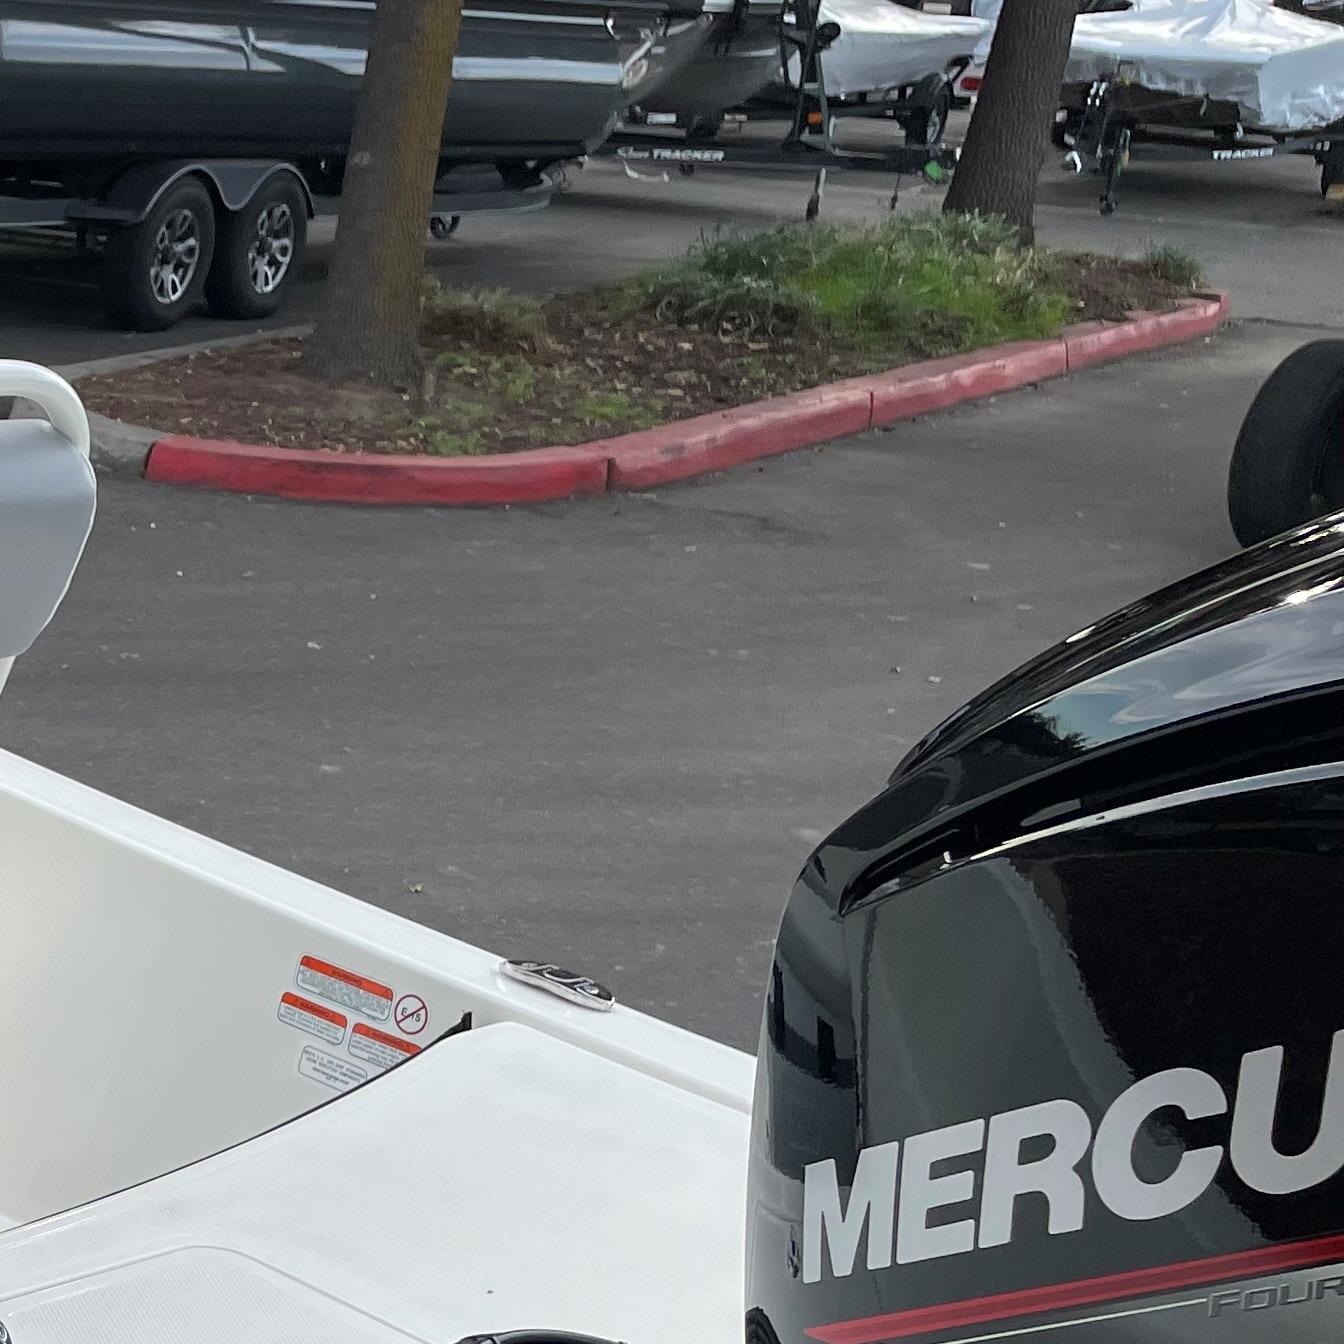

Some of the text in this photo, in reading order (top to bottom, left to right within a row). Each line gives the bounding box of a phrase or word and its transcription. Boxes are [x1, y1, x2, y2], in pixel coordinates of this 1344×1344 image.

[652, 148, 724, 161] TRACKER
[1212, 147, 1274, 160] TRACKER
[803, 1029, 1344, 1284] MERCU
